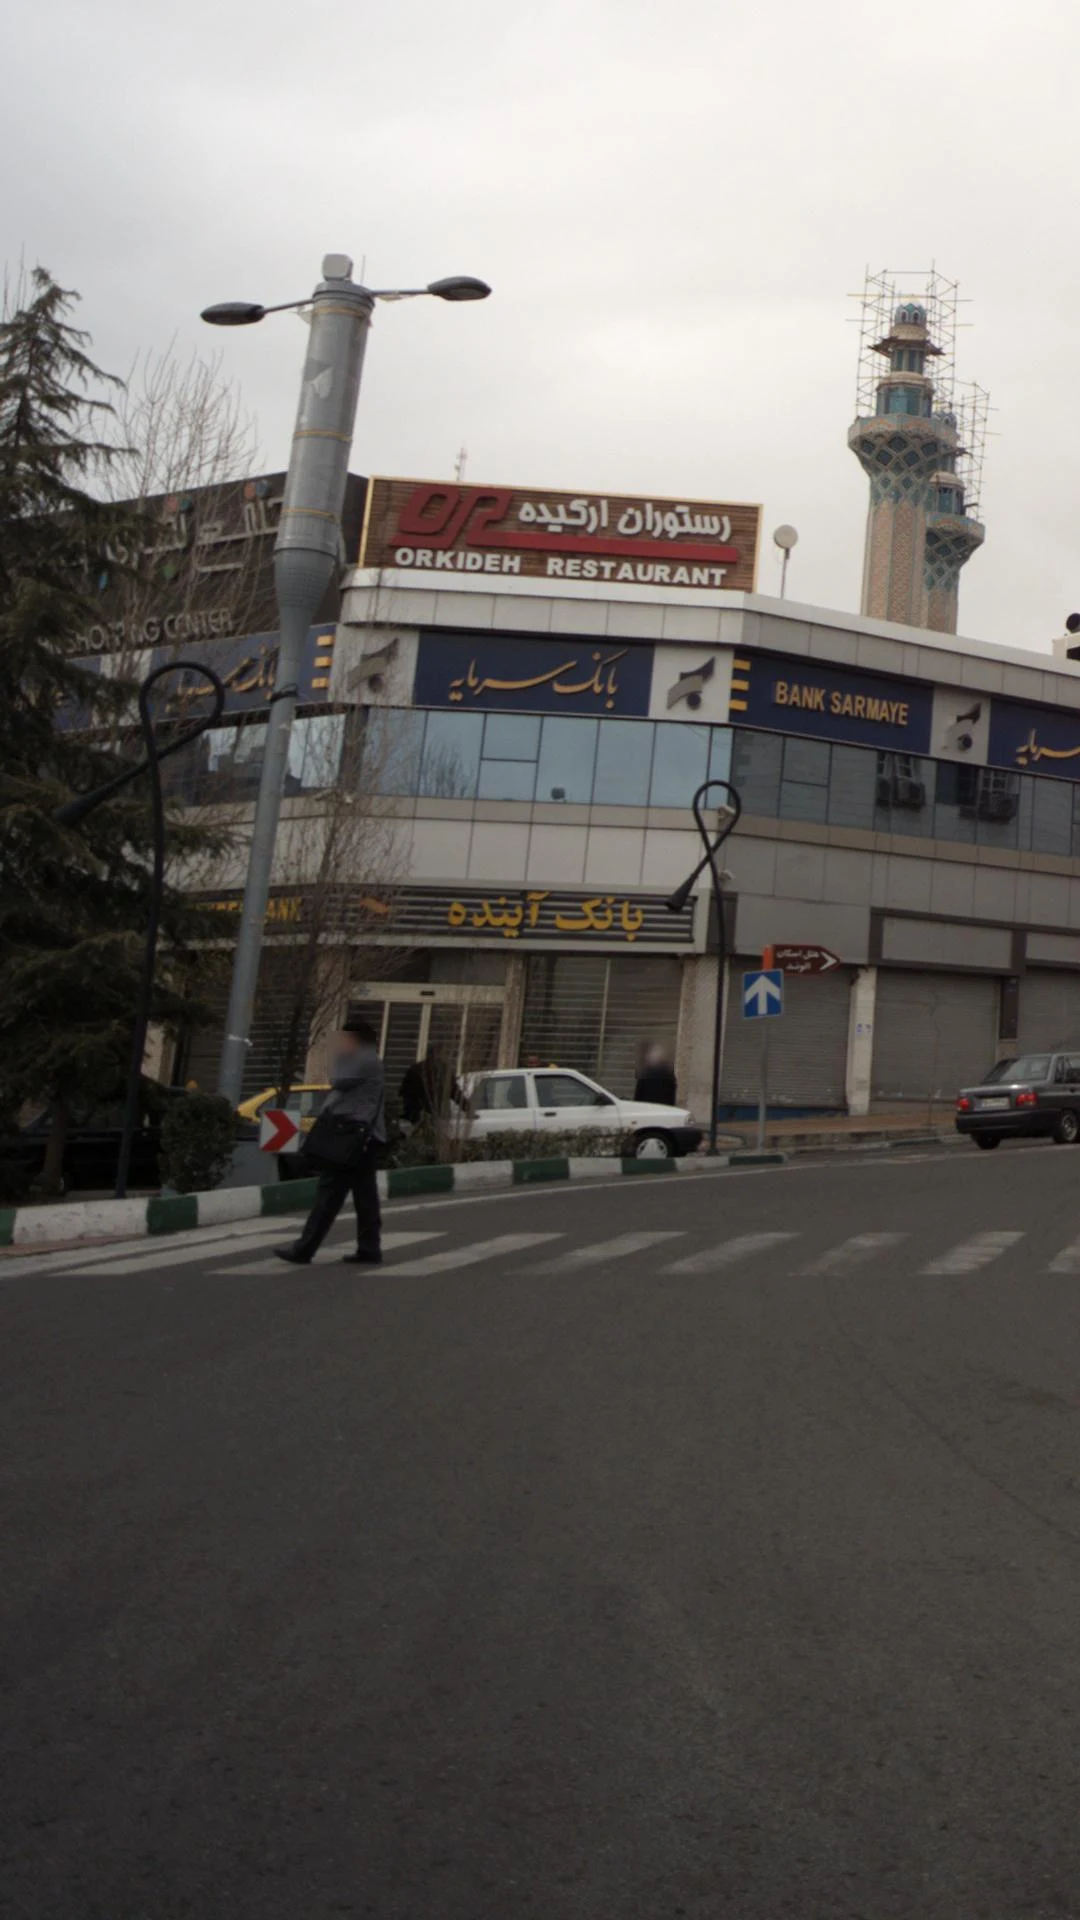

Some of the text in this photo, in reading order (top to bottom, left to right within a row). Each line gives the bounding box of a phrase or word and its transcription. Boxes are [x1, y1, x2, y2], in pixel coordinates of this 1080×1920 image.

[517, 499, 732, 542] رستوران ارکیده
[395, 547, 727, 587] ORKIDEH RESTAURANT
[447, 649, 629, 709] بانک سرمایه
[775, 680, 910, 727] BANK SARMAYE
[447, 891, 644, 942] بانک آینده
